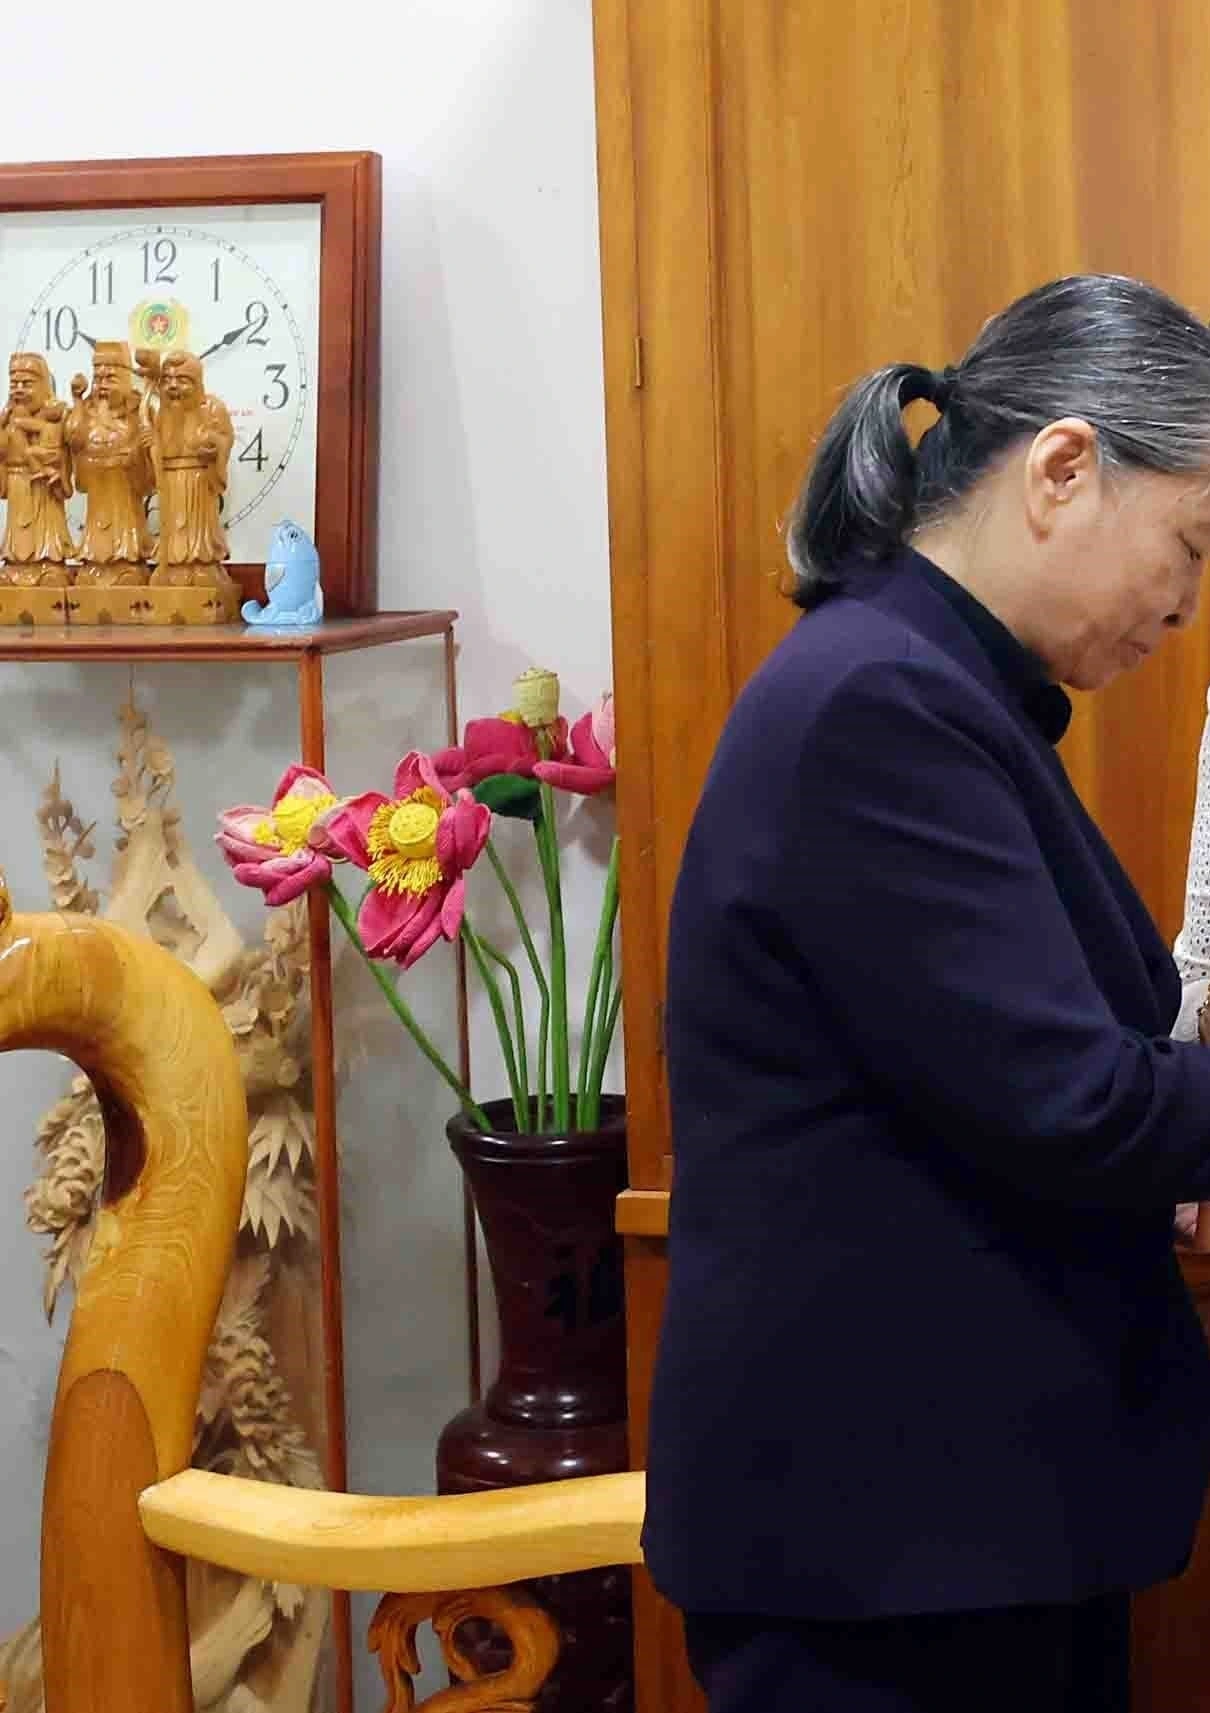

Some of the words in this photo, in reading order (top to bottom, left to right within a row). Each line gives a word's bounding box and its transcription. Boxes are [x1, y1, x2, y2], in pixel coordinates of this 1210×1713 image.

[88, 259, 114, 305] 11
[141, 238, 178, 285] 12
[210, 257, 221, 302] 1
[42, 305, 79, 351] 10
[245, 301, 271, 346] 2
[263, 363, 289, 411] 3
[238, 425, 269, 472] 4
